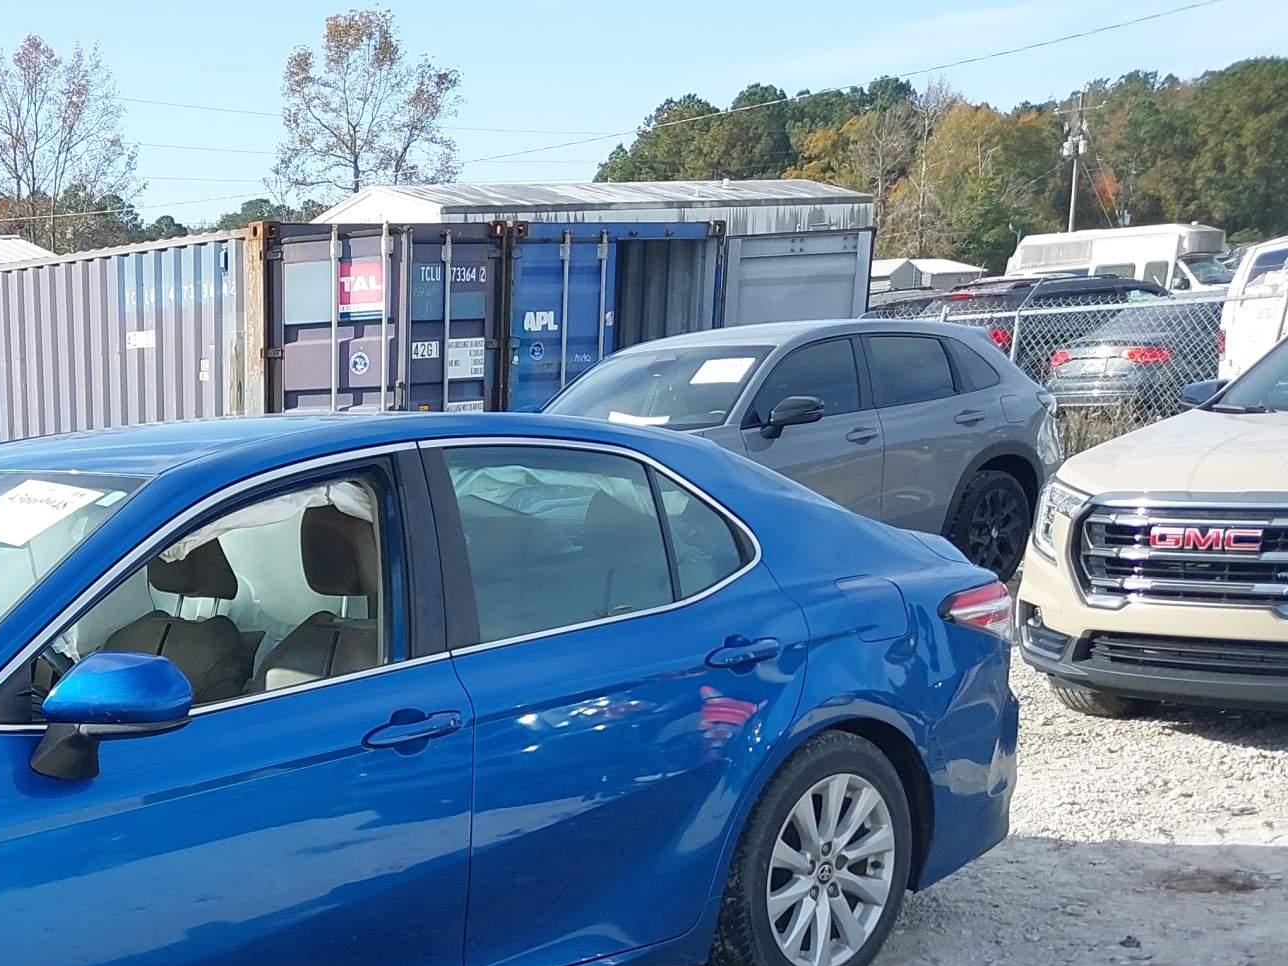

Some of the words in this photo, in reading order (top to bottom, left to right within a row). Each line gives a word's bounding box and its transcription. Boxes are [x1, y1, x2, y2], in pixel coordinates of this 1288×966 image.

[340, 274, 381, 293] TAL
[420, 266, 441, 282] TCLU
[479, 266, 487, 282] 2
[523, 311, 558, 332] APL
[413, 342, 439, 358] 42G1
[1149, 525, 1263, 550] GMC
